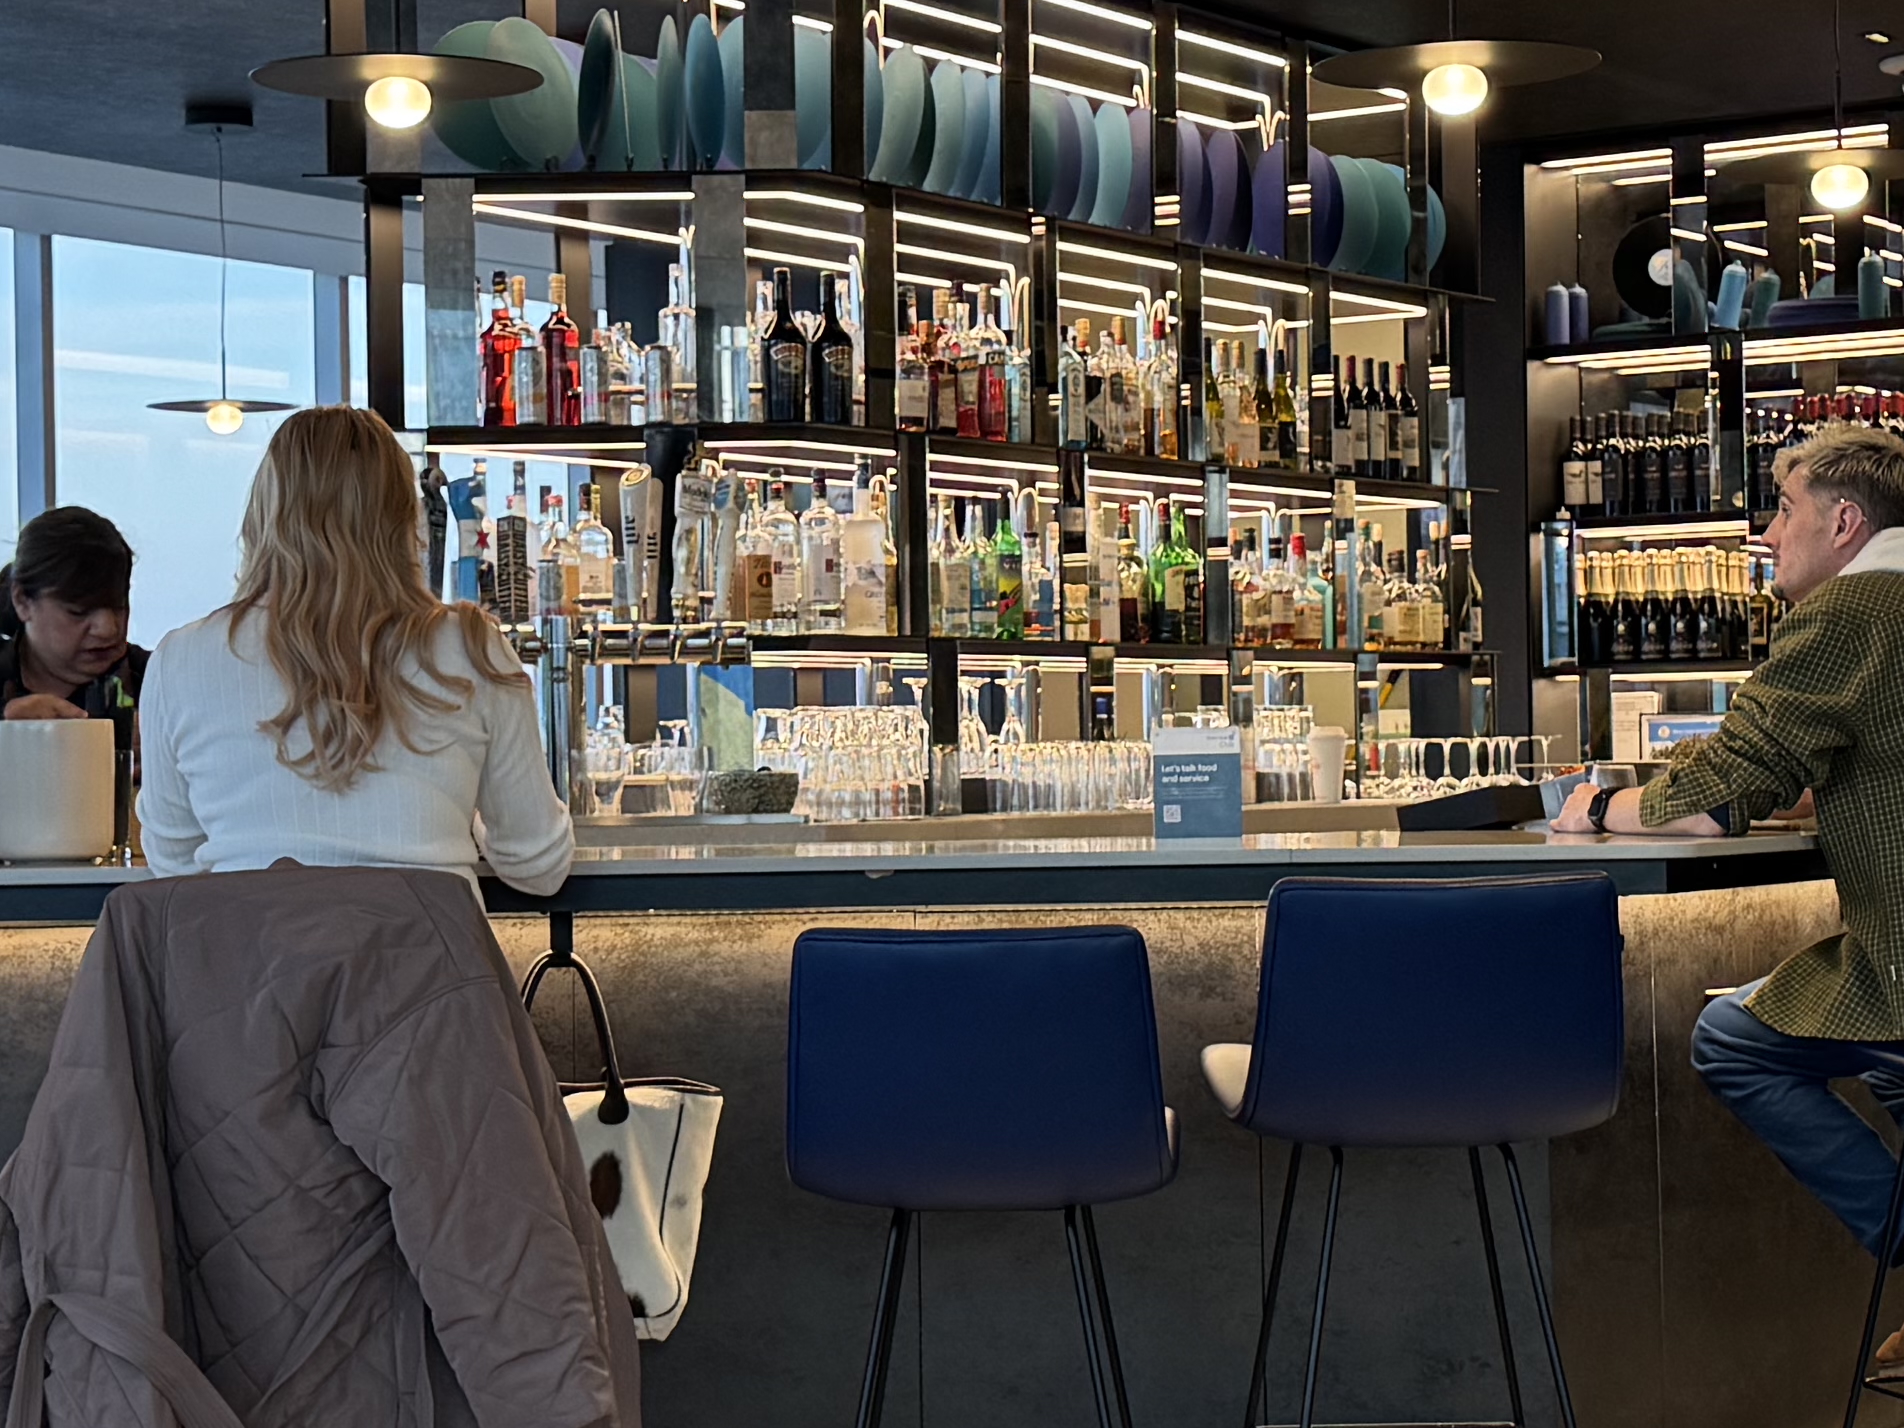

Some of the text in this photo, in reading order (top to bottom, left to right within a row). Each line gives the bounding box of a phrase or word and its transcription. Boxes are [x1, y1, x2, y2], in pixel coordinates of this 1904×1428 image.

[1161, 763, 1218, 773] Let's talk food
[1161, 774, 1210, 783] and service
